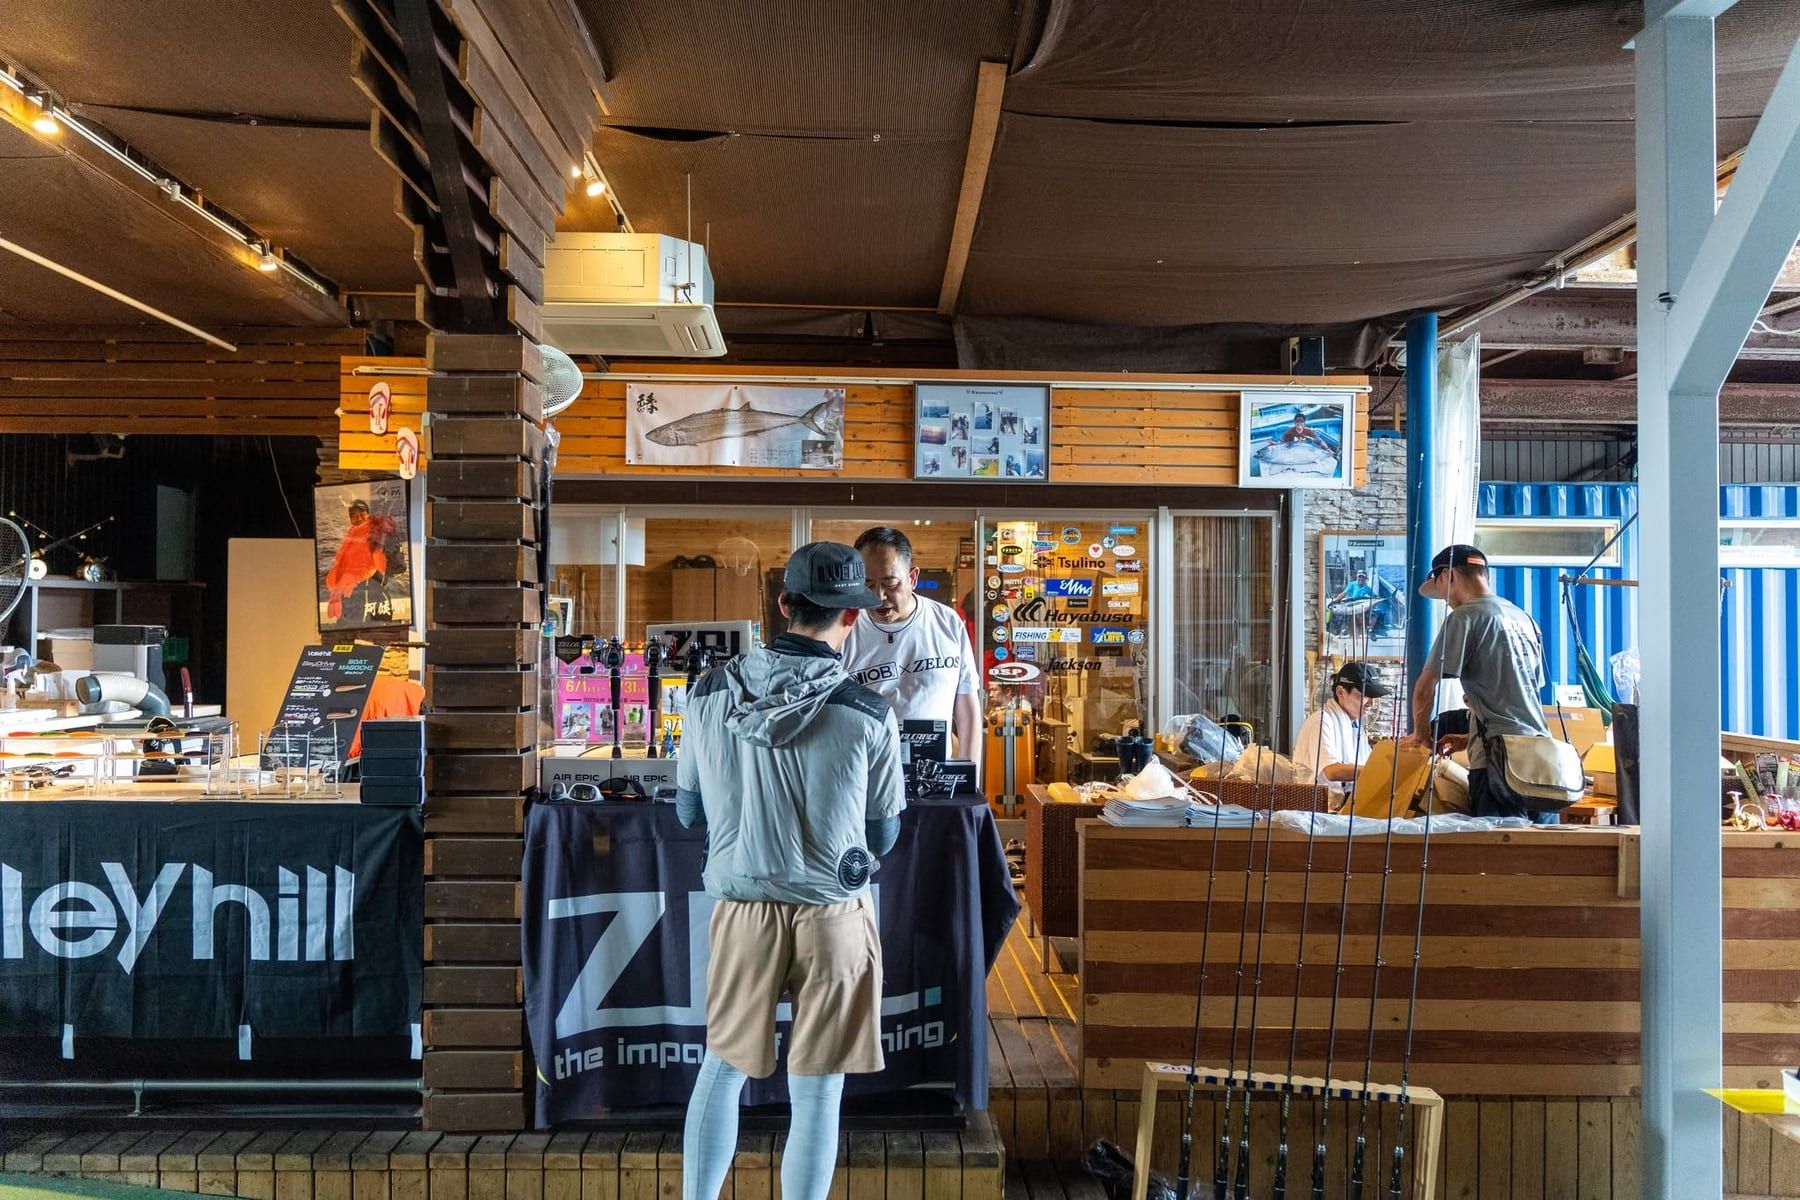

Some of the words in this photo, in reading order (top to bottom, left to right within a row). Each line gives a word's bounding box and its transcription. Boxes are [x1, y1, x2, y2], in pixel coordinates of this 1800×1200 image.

[1058, 557, 1105, 569] Tsulino
[1045, 610, 1133, 624] Hayabusa
[1015, 631, 1047, 640] FISHING
[913, 656, 960, 672] ZELOS
[1045, 658, 1101, 672] Jackson
[553, 773, 571, 781] AIR
[644, 774, 668, 782] EPIC
[554, 1046, 604, 1080] the
